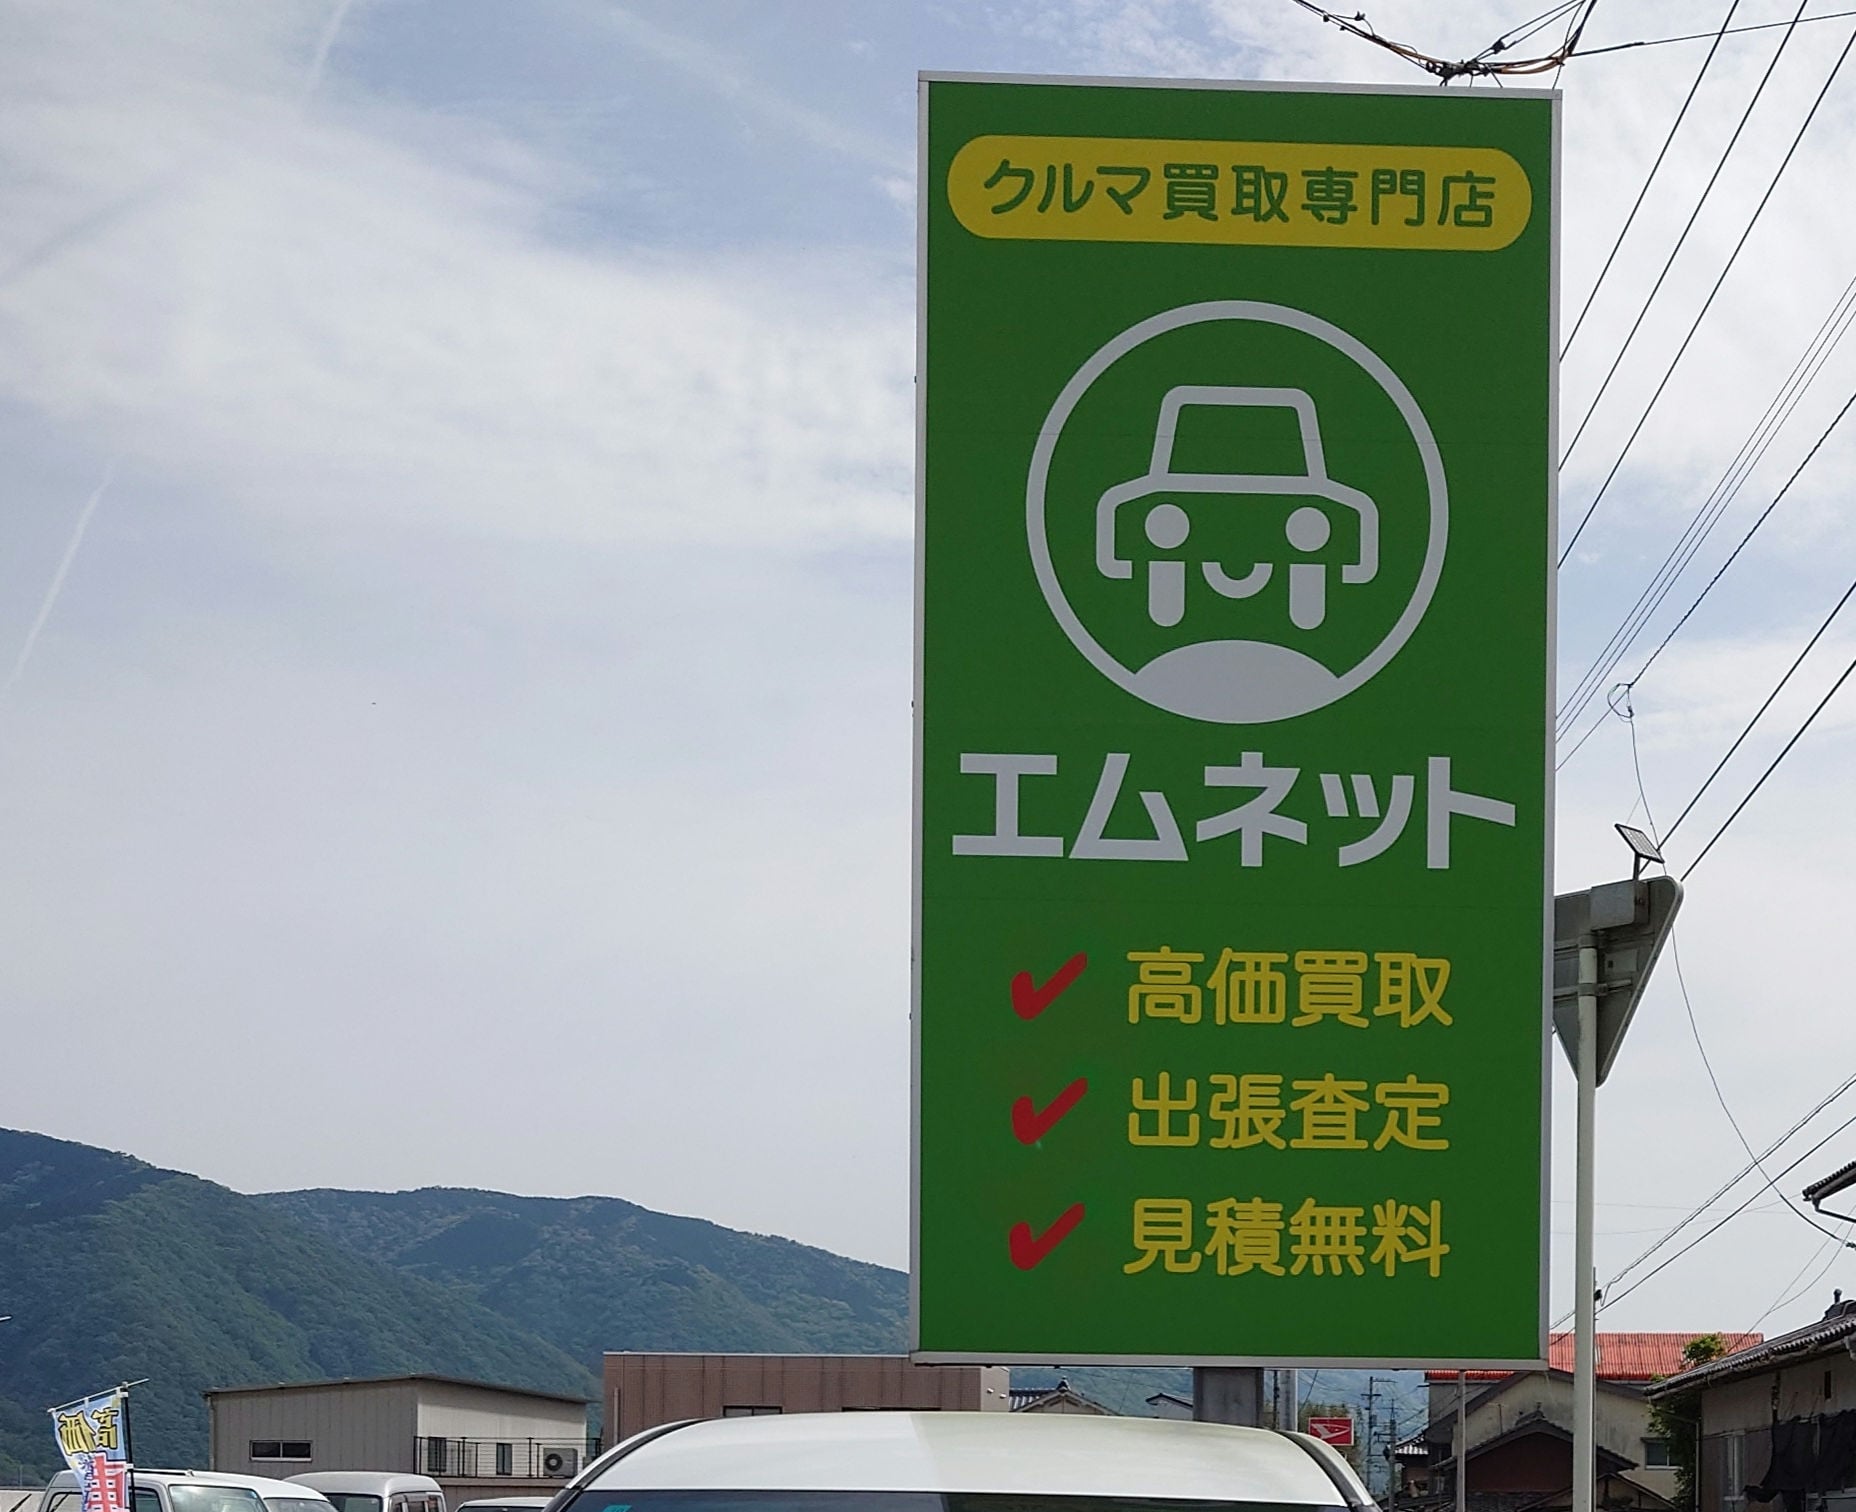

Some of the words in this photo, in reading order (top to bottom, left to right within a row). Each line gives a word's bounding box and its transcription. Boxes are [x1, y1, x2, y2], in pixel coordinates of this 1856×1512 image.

[983, 159, 1496, 229] クルマ買取専門店
[951, 751, 1517, 870] エムネット
[1125, 945, 1453, 1028] 高価買取
[1127, 1071, 1450, 1151] 出張査定
[1123, 1197, 1450, 1278] 見積無料
